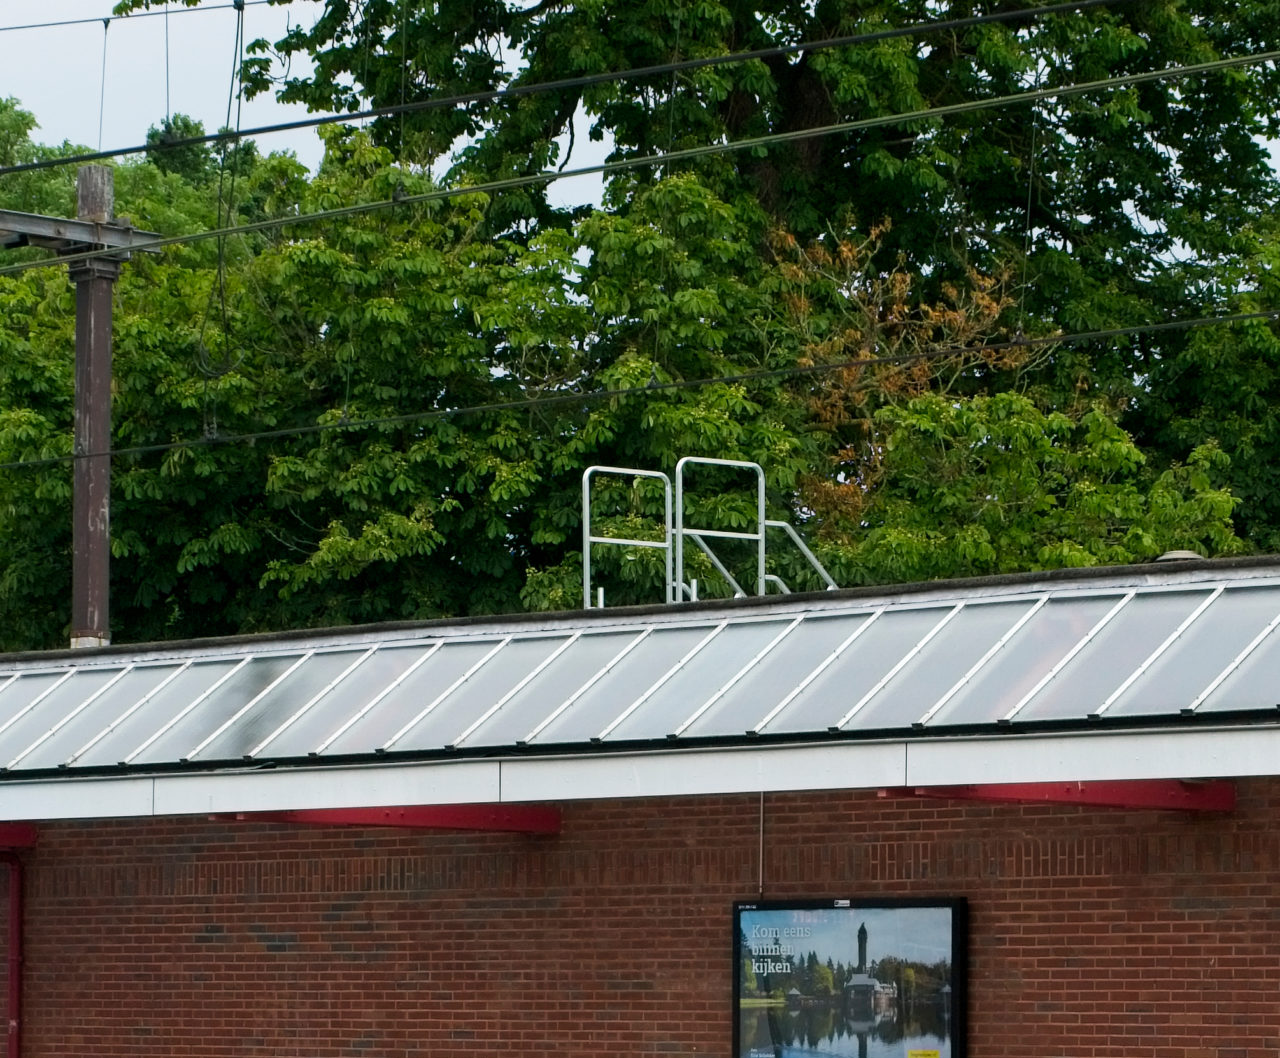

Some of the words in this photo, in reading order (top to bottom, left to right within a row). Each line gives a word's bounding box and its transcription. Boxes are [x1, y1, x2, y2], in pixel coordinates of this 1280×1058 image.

[751, 924, 780, 938] Kom
[783, 927, 811, 938] eens
[751, 943, 795, 956] binnen
[751, 959, 792, 977] kijken
